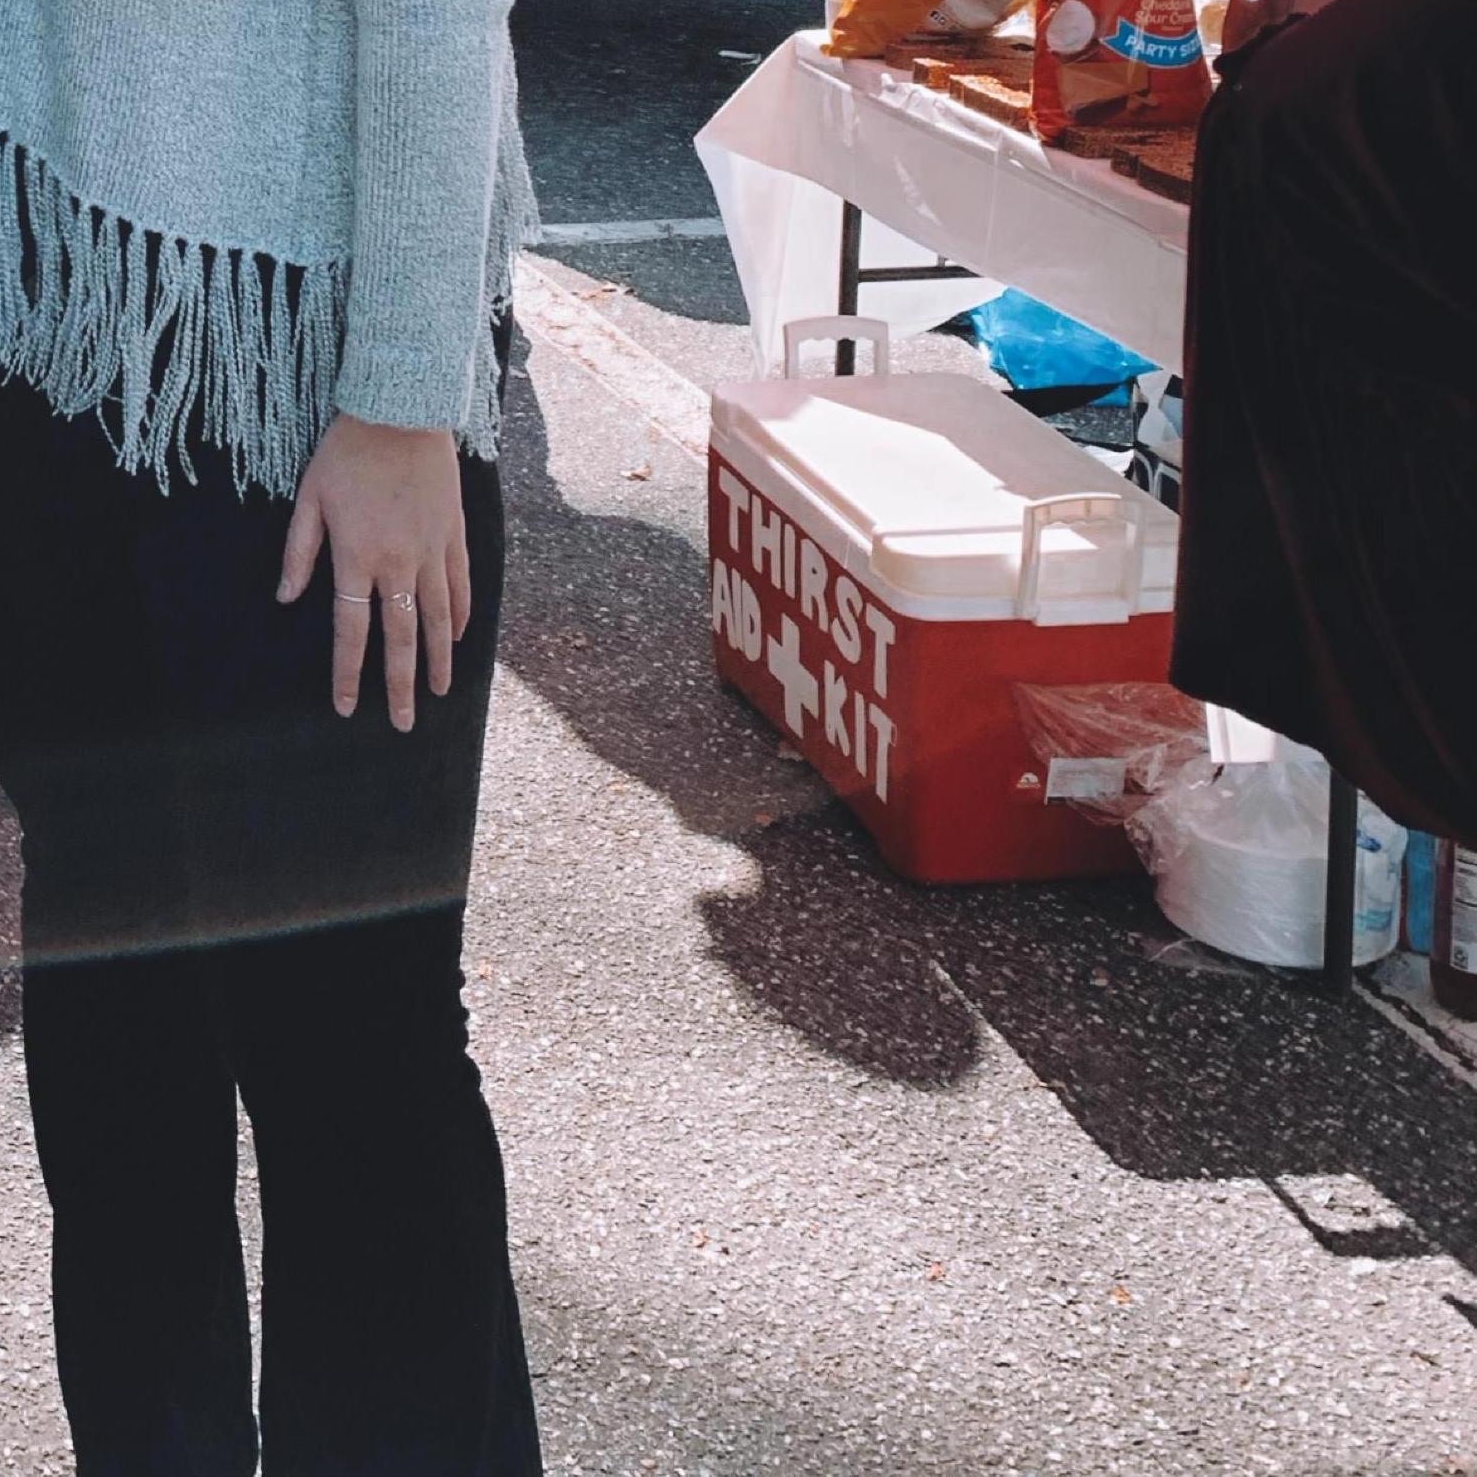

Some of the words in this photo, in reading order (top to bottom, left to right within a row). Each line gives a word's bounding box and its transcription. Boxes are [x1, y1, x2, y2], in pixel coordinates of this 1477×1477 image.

[1125, 34, 1177, 60] PARTY
[1179, 35, 1202, 58] SIZ
[1134, 10, 1168, 24] Sour
[718, 465, 896, 700] THIRST
[711, 557, 762, 663] AID
[824, 659, 893, 805] KIT
